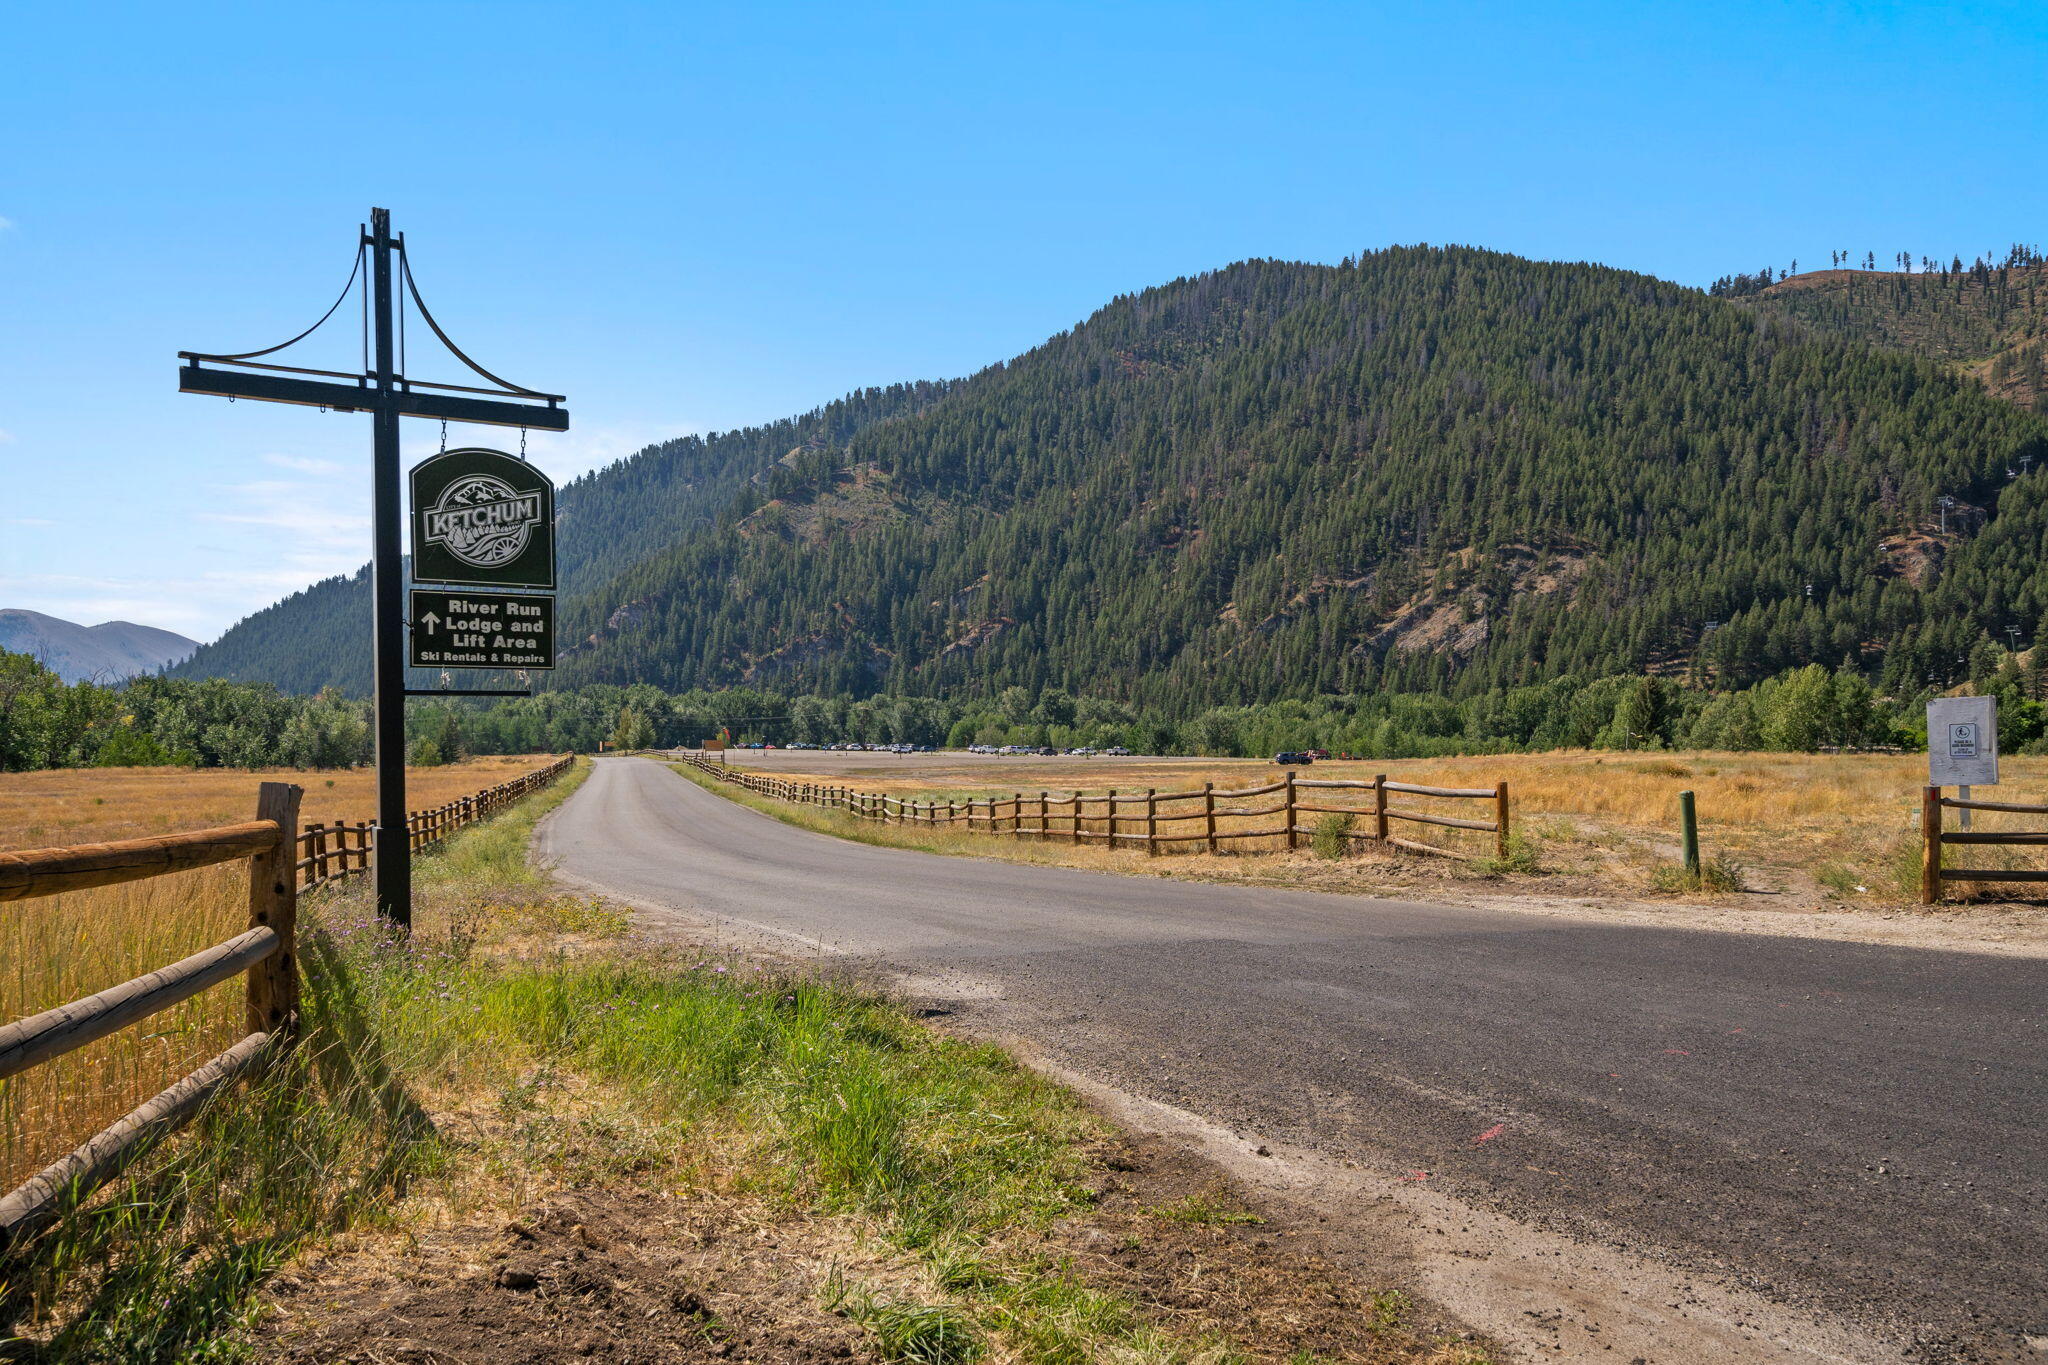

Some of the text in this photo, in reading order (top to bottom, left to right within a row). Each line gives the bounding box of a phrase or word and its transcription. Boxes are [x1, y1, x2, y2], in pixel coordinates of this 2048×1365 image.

[432, 498, 534, 535] KETCHUM
[448, 599, 541, 616] River Run
[446, 616, 544, 634] Lodge and
[453, 633, 537, 649] Lift Area
[420, 651, 545, 664] Ski Rentals & Repairs
